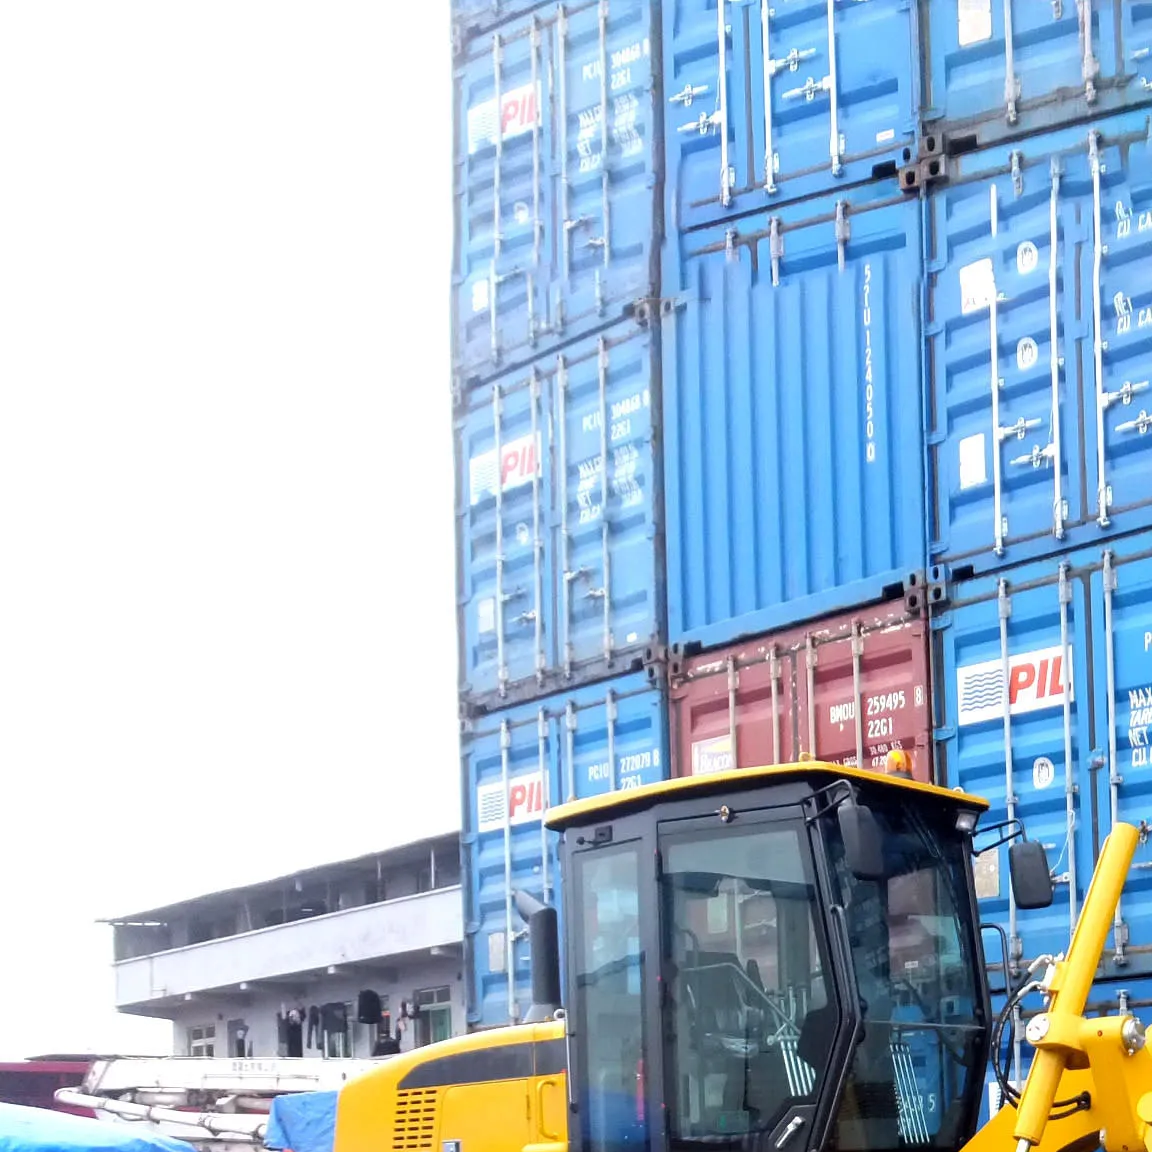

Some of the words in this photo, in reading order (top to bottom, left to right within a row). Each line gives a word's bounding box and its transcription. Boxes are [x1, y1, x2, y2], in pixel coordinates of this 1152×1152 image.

[1009, 655, 1067, 704] PIL
[830, 701, 855, 724] BMOU
[867, 691, 905, 716] 259495
[914, 686, 923, 705] 8
[868, 717, 893, 739] 22G1
[1128, 726, 1149, 747] NET
[588, 762, 609, 782] PCIU
[620, 752, 650, 773] 272079
[653, 749, 660, 767] 8
[509, 781, 547, 817] PIL
